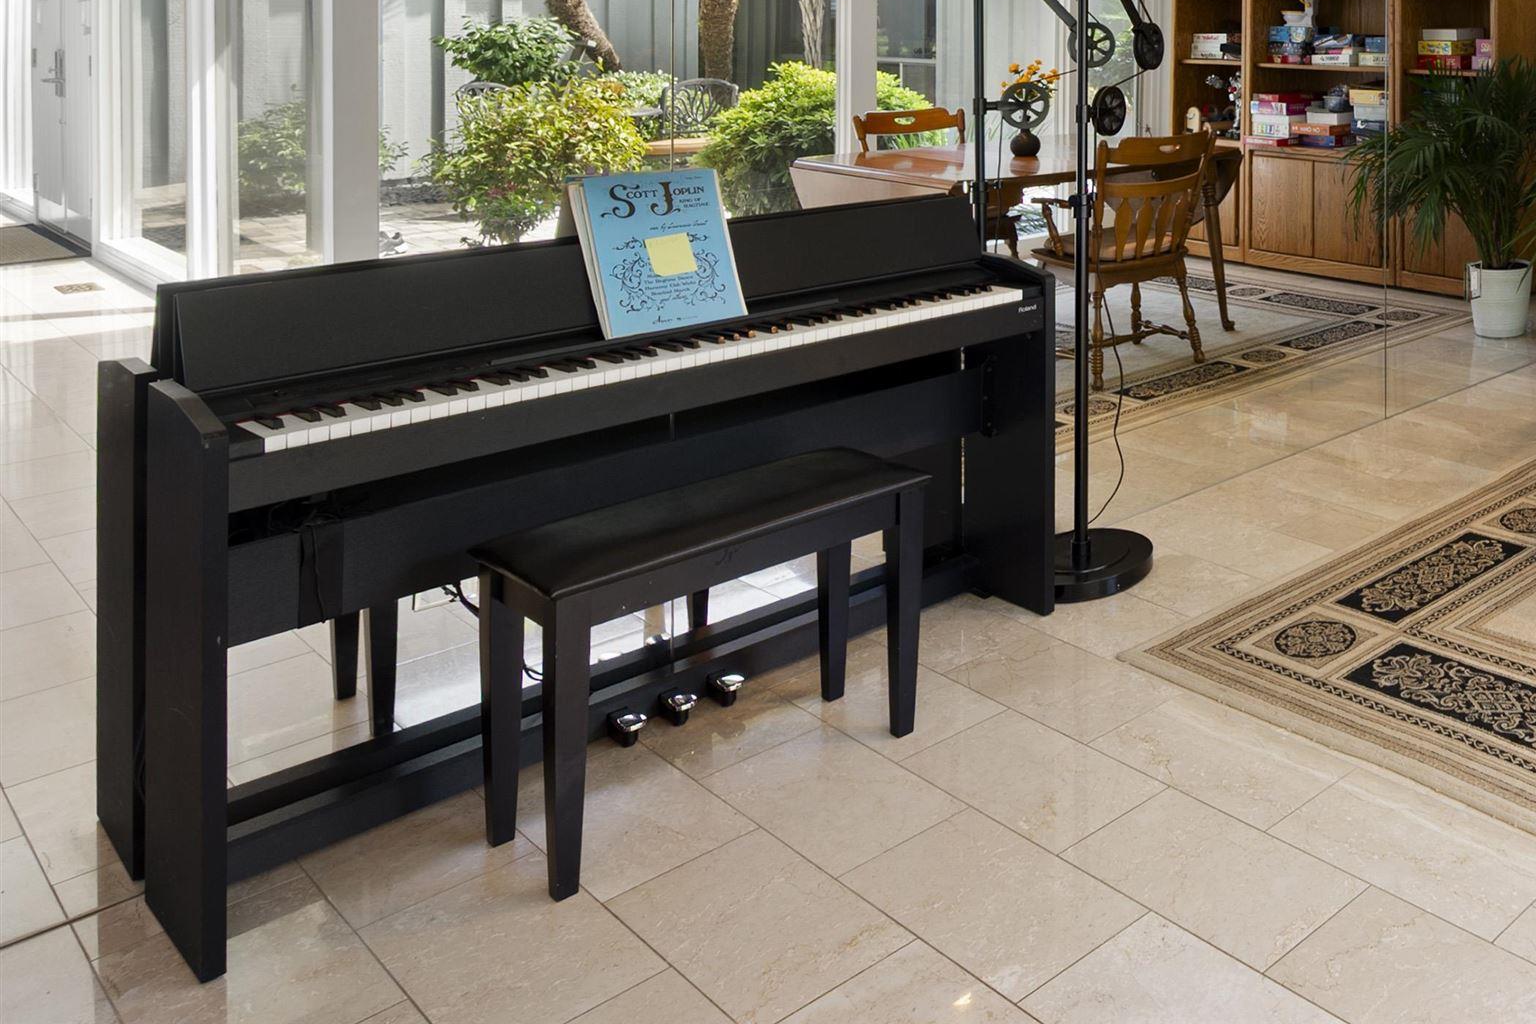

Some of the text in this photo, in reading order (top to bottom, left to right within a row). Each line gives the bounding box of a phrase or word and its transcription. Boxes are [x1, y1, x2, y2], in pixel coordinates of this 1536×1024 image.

[601, 181, 705, 219] SCOTT JOPLIN
[1018, 304, 1037, 313] Roland
